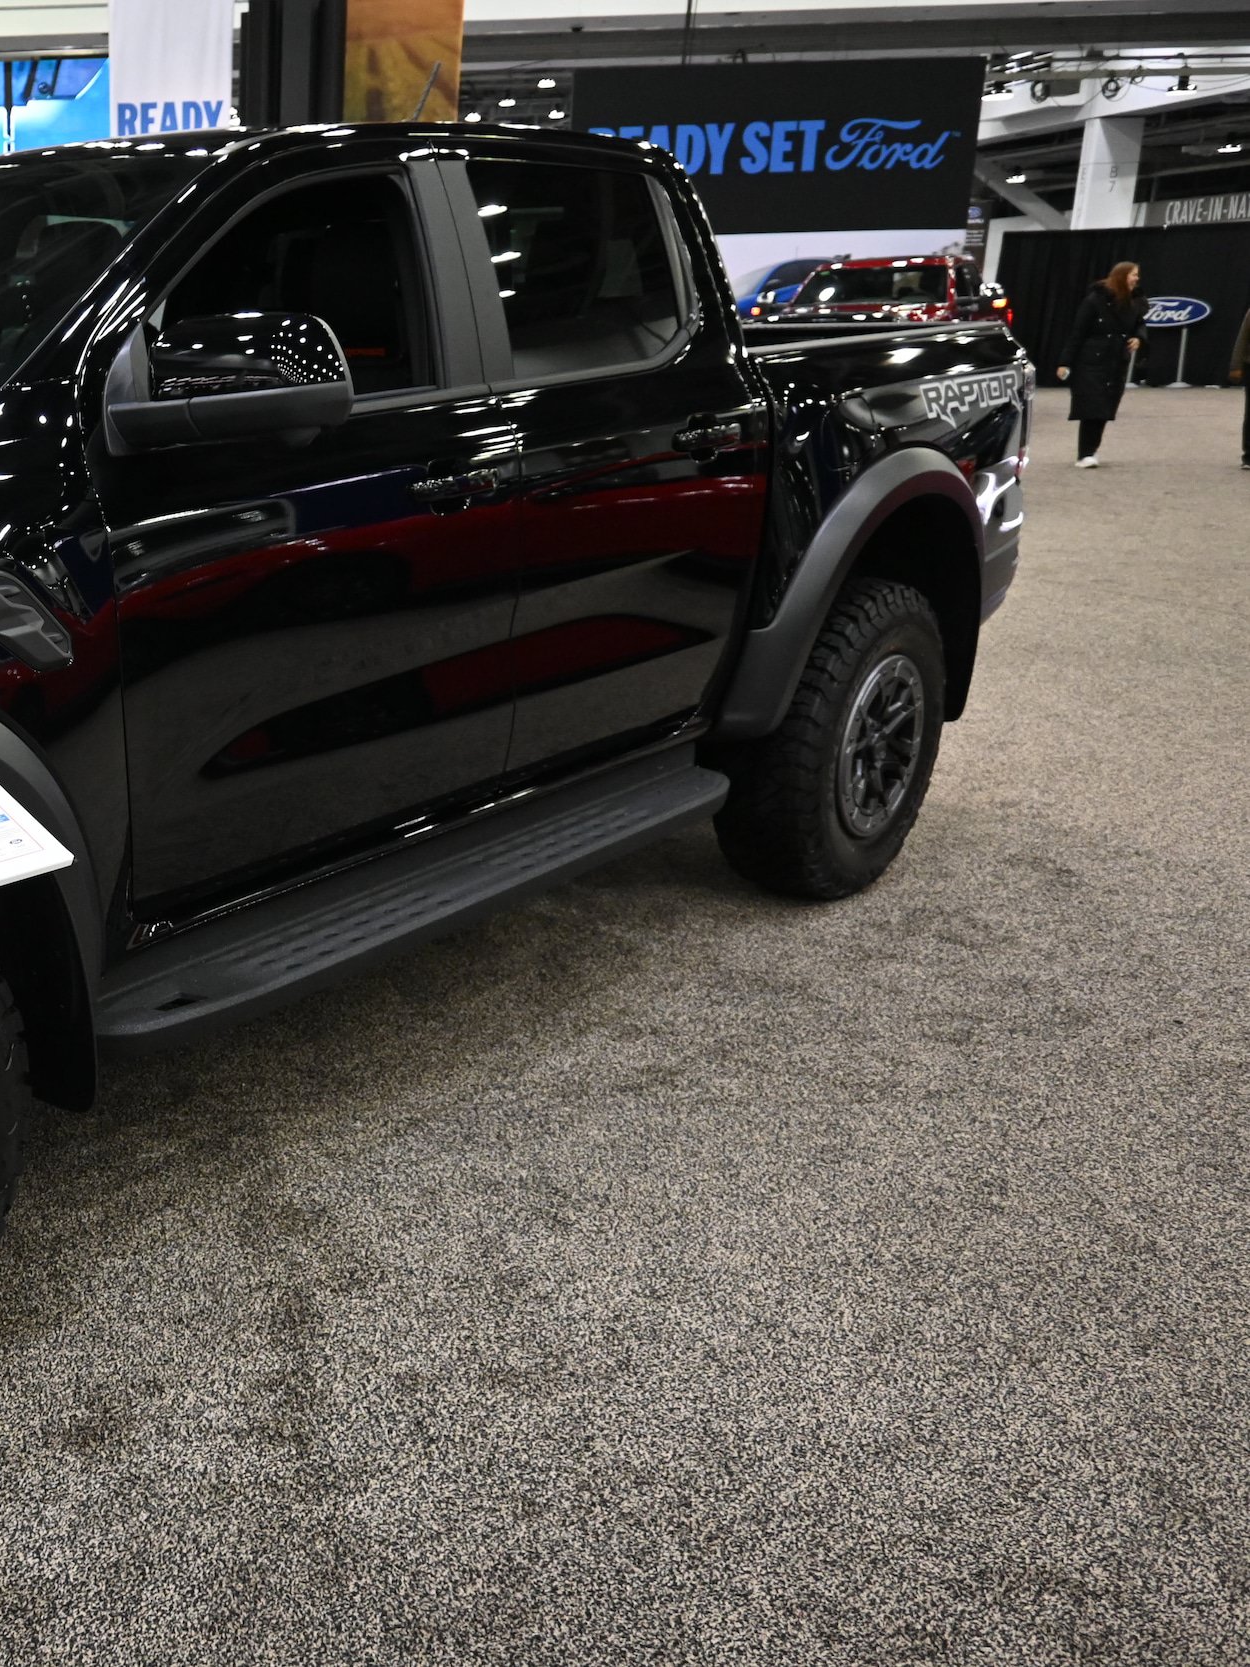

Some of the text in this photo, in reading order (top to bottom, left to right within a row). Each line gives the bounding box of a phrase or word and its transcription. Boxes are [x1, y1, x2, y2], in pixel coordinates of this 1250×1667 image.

[117, 100, 223, 137] READY
[740, 119, 826, 174] SET
[824, 117, 951, 171] Ford
[1143, 301, 1193, 321] Ford
[919, 369, 1024, 430] RAPTOR
